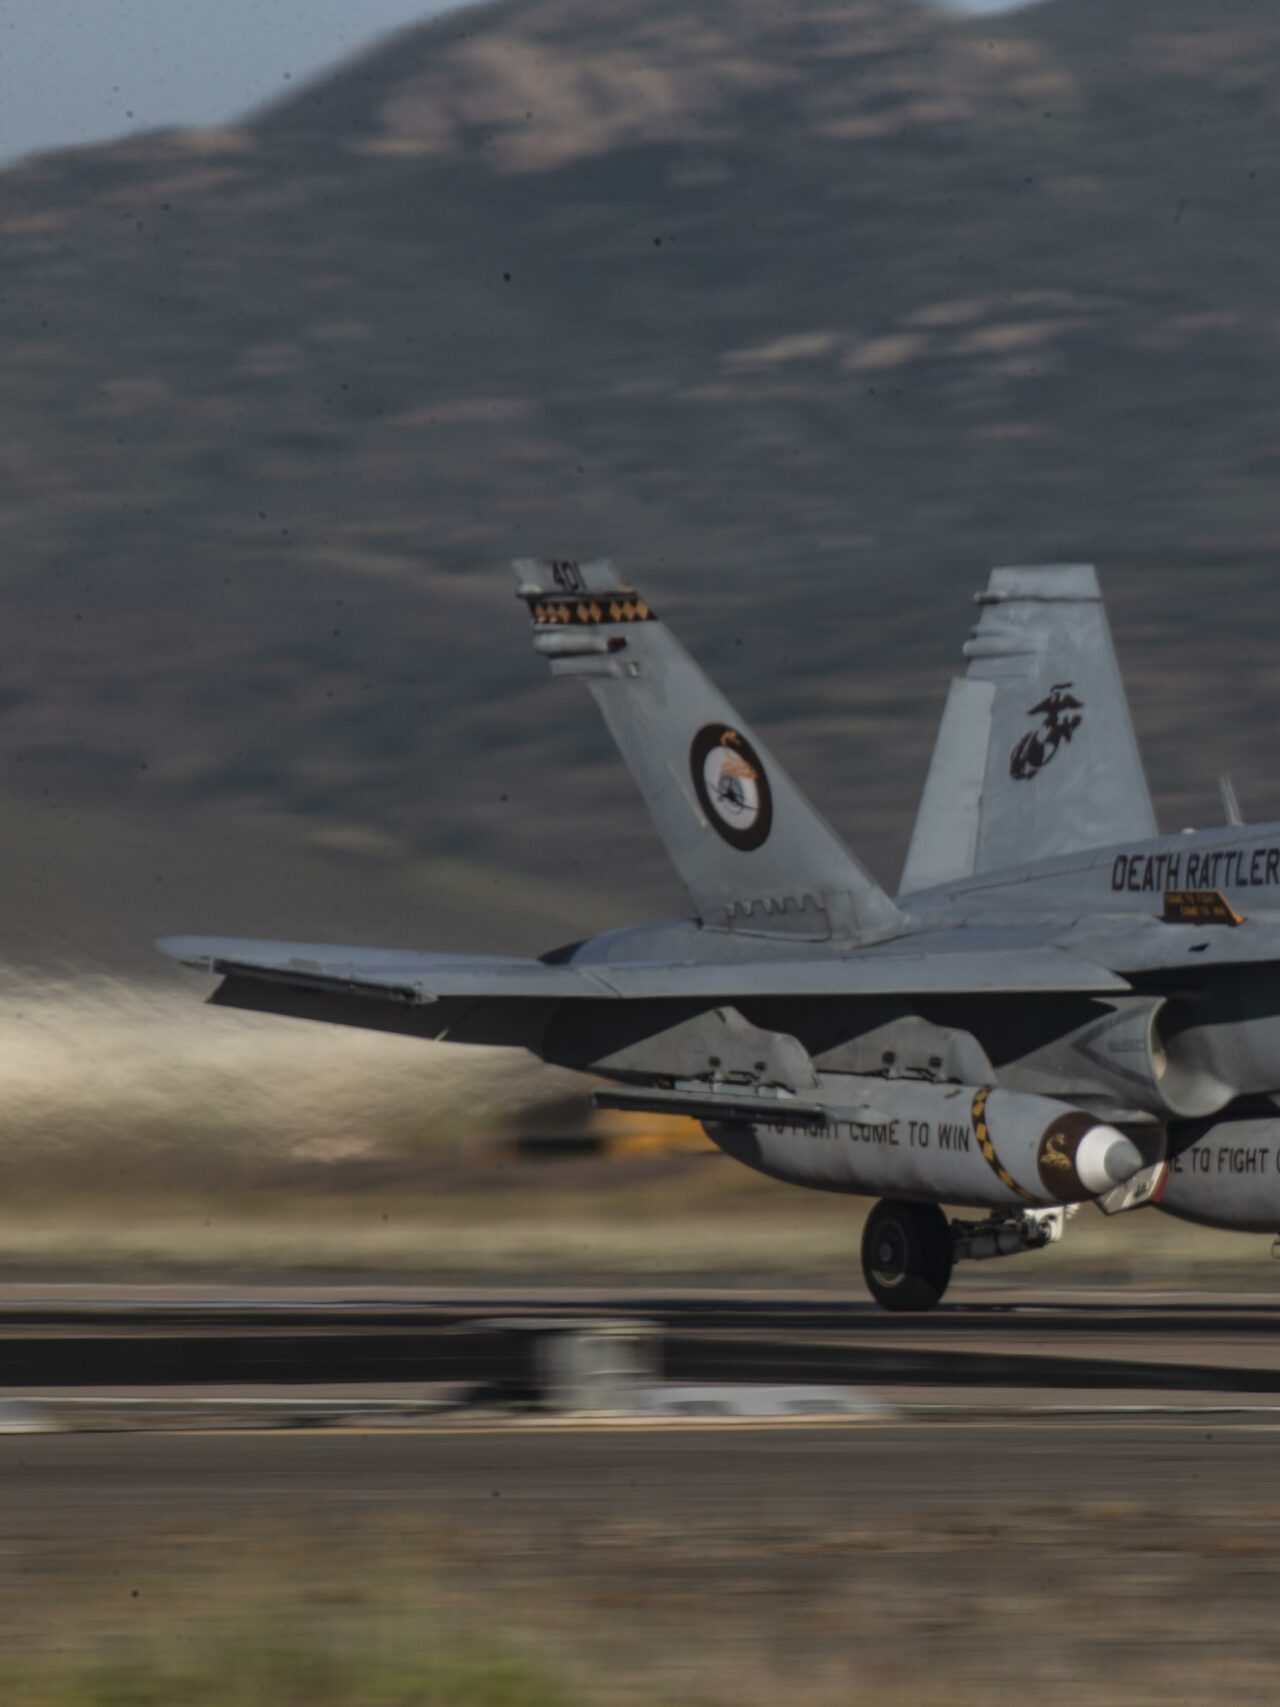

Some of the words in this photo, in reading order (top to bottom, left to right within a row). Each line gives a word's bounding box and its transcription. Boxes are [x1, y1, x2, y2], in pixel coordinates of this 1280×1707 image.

[552, 559, 585, 592] 401
[1111, 853, 1178, 891] DEATH
[849, 1120, 899, 1146] COME
[908, 1120, 929, 1148] TO
[938, 1123, 970, 1152] WIN
[1191, 1148, 1210, 1173] TO
[1218, 1148, 1269, 1173] FIGHT
